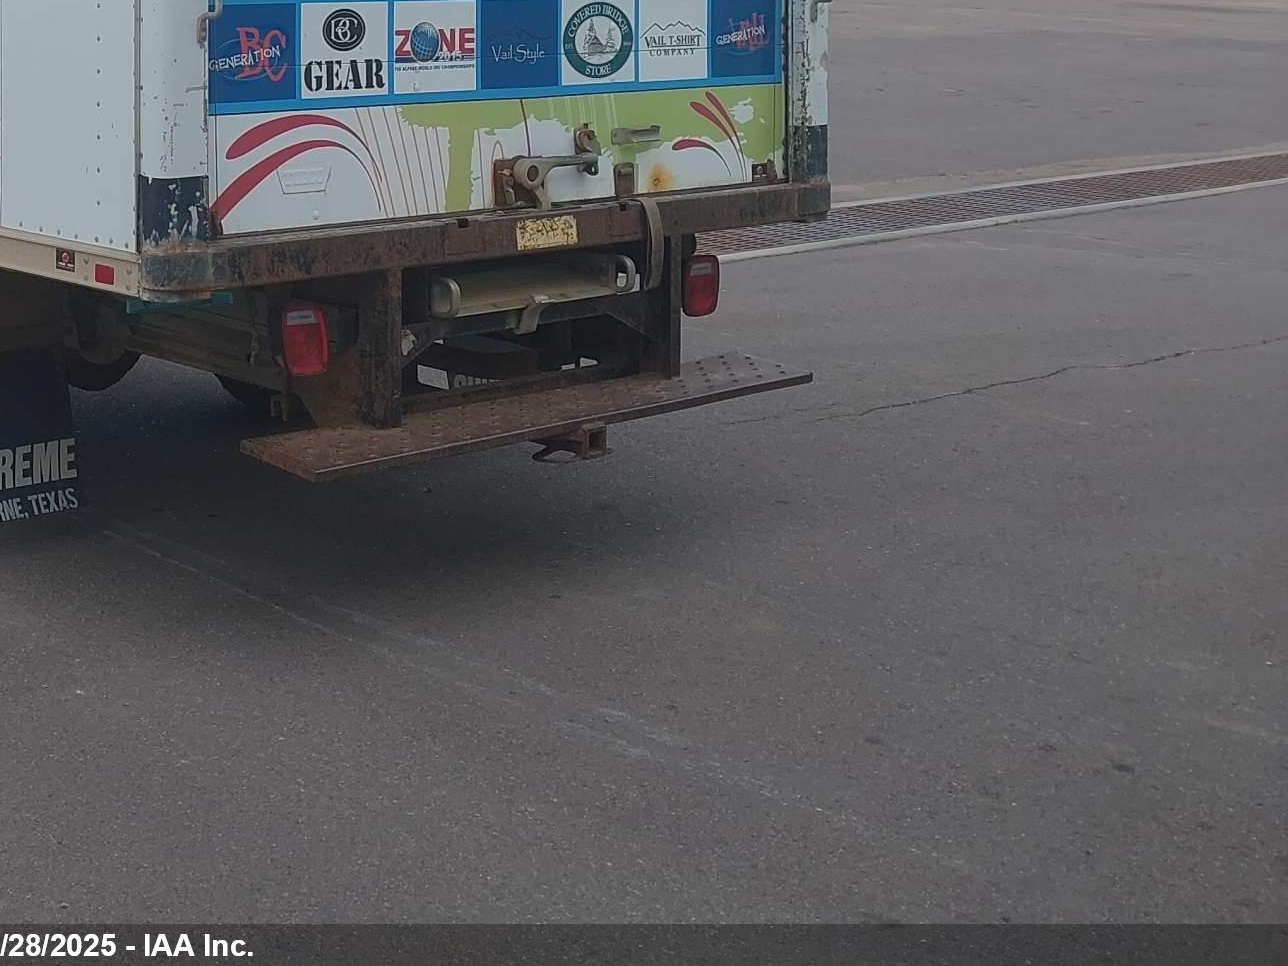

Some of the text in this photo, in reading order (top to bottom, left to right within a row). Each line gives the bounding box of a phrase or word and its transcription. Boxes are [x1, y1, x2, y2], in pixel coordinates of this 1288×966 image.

[568, 4, 630, 38] COVERED BRIDGE
[644, 35, 667, 48] VAIL
[669, 34, 703, 47] T-SHIRT
[715, 25, 766, 45] GENERATION
[208, 45, 281, 72] GENERATION
[438, 50, 463, 62] 2015
[491, 43, 545, 65] Vail Style
[649, 47, 696, 57] COMPANY
[303, 58, 386, 92] GEAR
[585, 63, 612, 76] STORE
[28, 487, 79, 516] TEXAS
